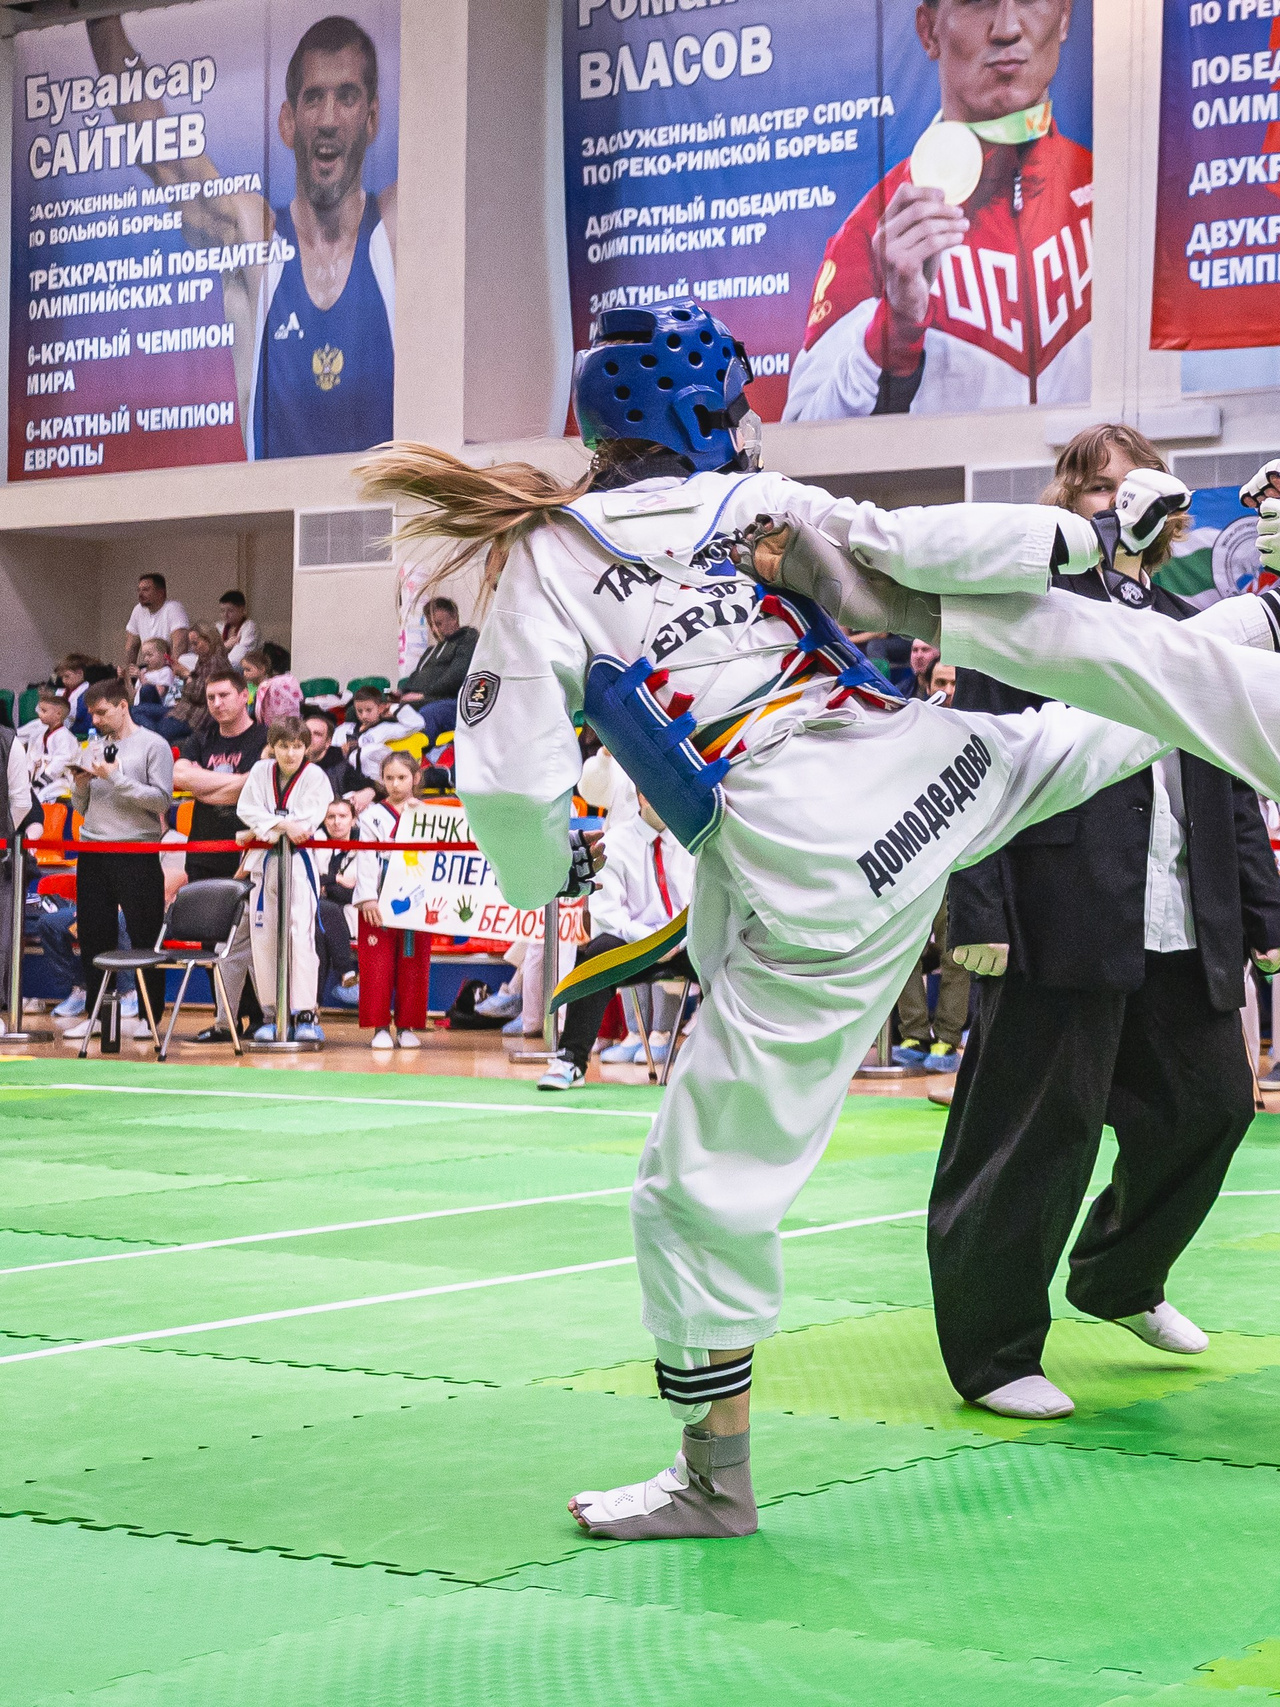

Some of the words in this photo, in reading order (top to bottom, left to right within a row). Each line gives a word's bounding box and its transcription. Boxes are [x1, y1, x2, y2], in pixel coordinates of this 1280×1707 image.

[1190, 2, 1222, 27] ПО
[580, 25, 774, 99] ВЛАСОВ
[26, 56, 216, 127] Бувайсар
[29, 112, 206, 180] САЙТИЕВ
[582, 113, 726, 158] ЗАСЛУЖЕННЫЙ
[731, 106, 808, 135] МАСТЕР
[813, 95, 895, 126] СПОРТА
[583, 164, 611, 186] ПО
[612, 137, 770, 181] ГРЕКО-РИМСКОЙ
[775, 129, 858, 160] БОРЬБЕ
[30, 186, 138, 222] ЗАСЛУЖЕННЫЙ
[141, 181, 200, 207] МАСТЕР
[203, 173, 261, 197] СПОРТА
[585, 194, 705, 240] ДВУКРАТНЫЙ
[711, 185, 836, 219] ПОБЕДИТЕЛЬ
[29, 229, 46, 248] ПО
[49, 215, 119, 245] ВОЛЬНОЙ
[122, 211, 183, 236] БОРЬБЕ
[588, 227, 726, 263] ОЛИМПИЙСКИХ
[731, 222, 767, 246] ИГР
[29, 248, 163, 292] ТРЁХКРАТНЫЙ
[168, 239, 295, 275] ПОБЕДИТЕЛЬ
[930, 217, 1093, 353] ОССИ
[29, 282, 172, 320] ОЛИМПИЙСКИХ
[177, 278, 214, 305] ИГР
[589, 277, 690, 314] 3-КРАТНЫЙ
[693, 272, 790, 302] ЧЕМПИОН
[28, 327, 131, 367] 6-КРАТНЫЙ
[136, 322, 234, 355] ЧЕМПИОН
[27, 369, 76, 396] МИРА
[26, 404, 131, 442] 6-КРАТНЫЙ
[136, 401, 234, 432] ЧЕМПИОН
[24, 442, 104, 472] ЕВРОПЫ
